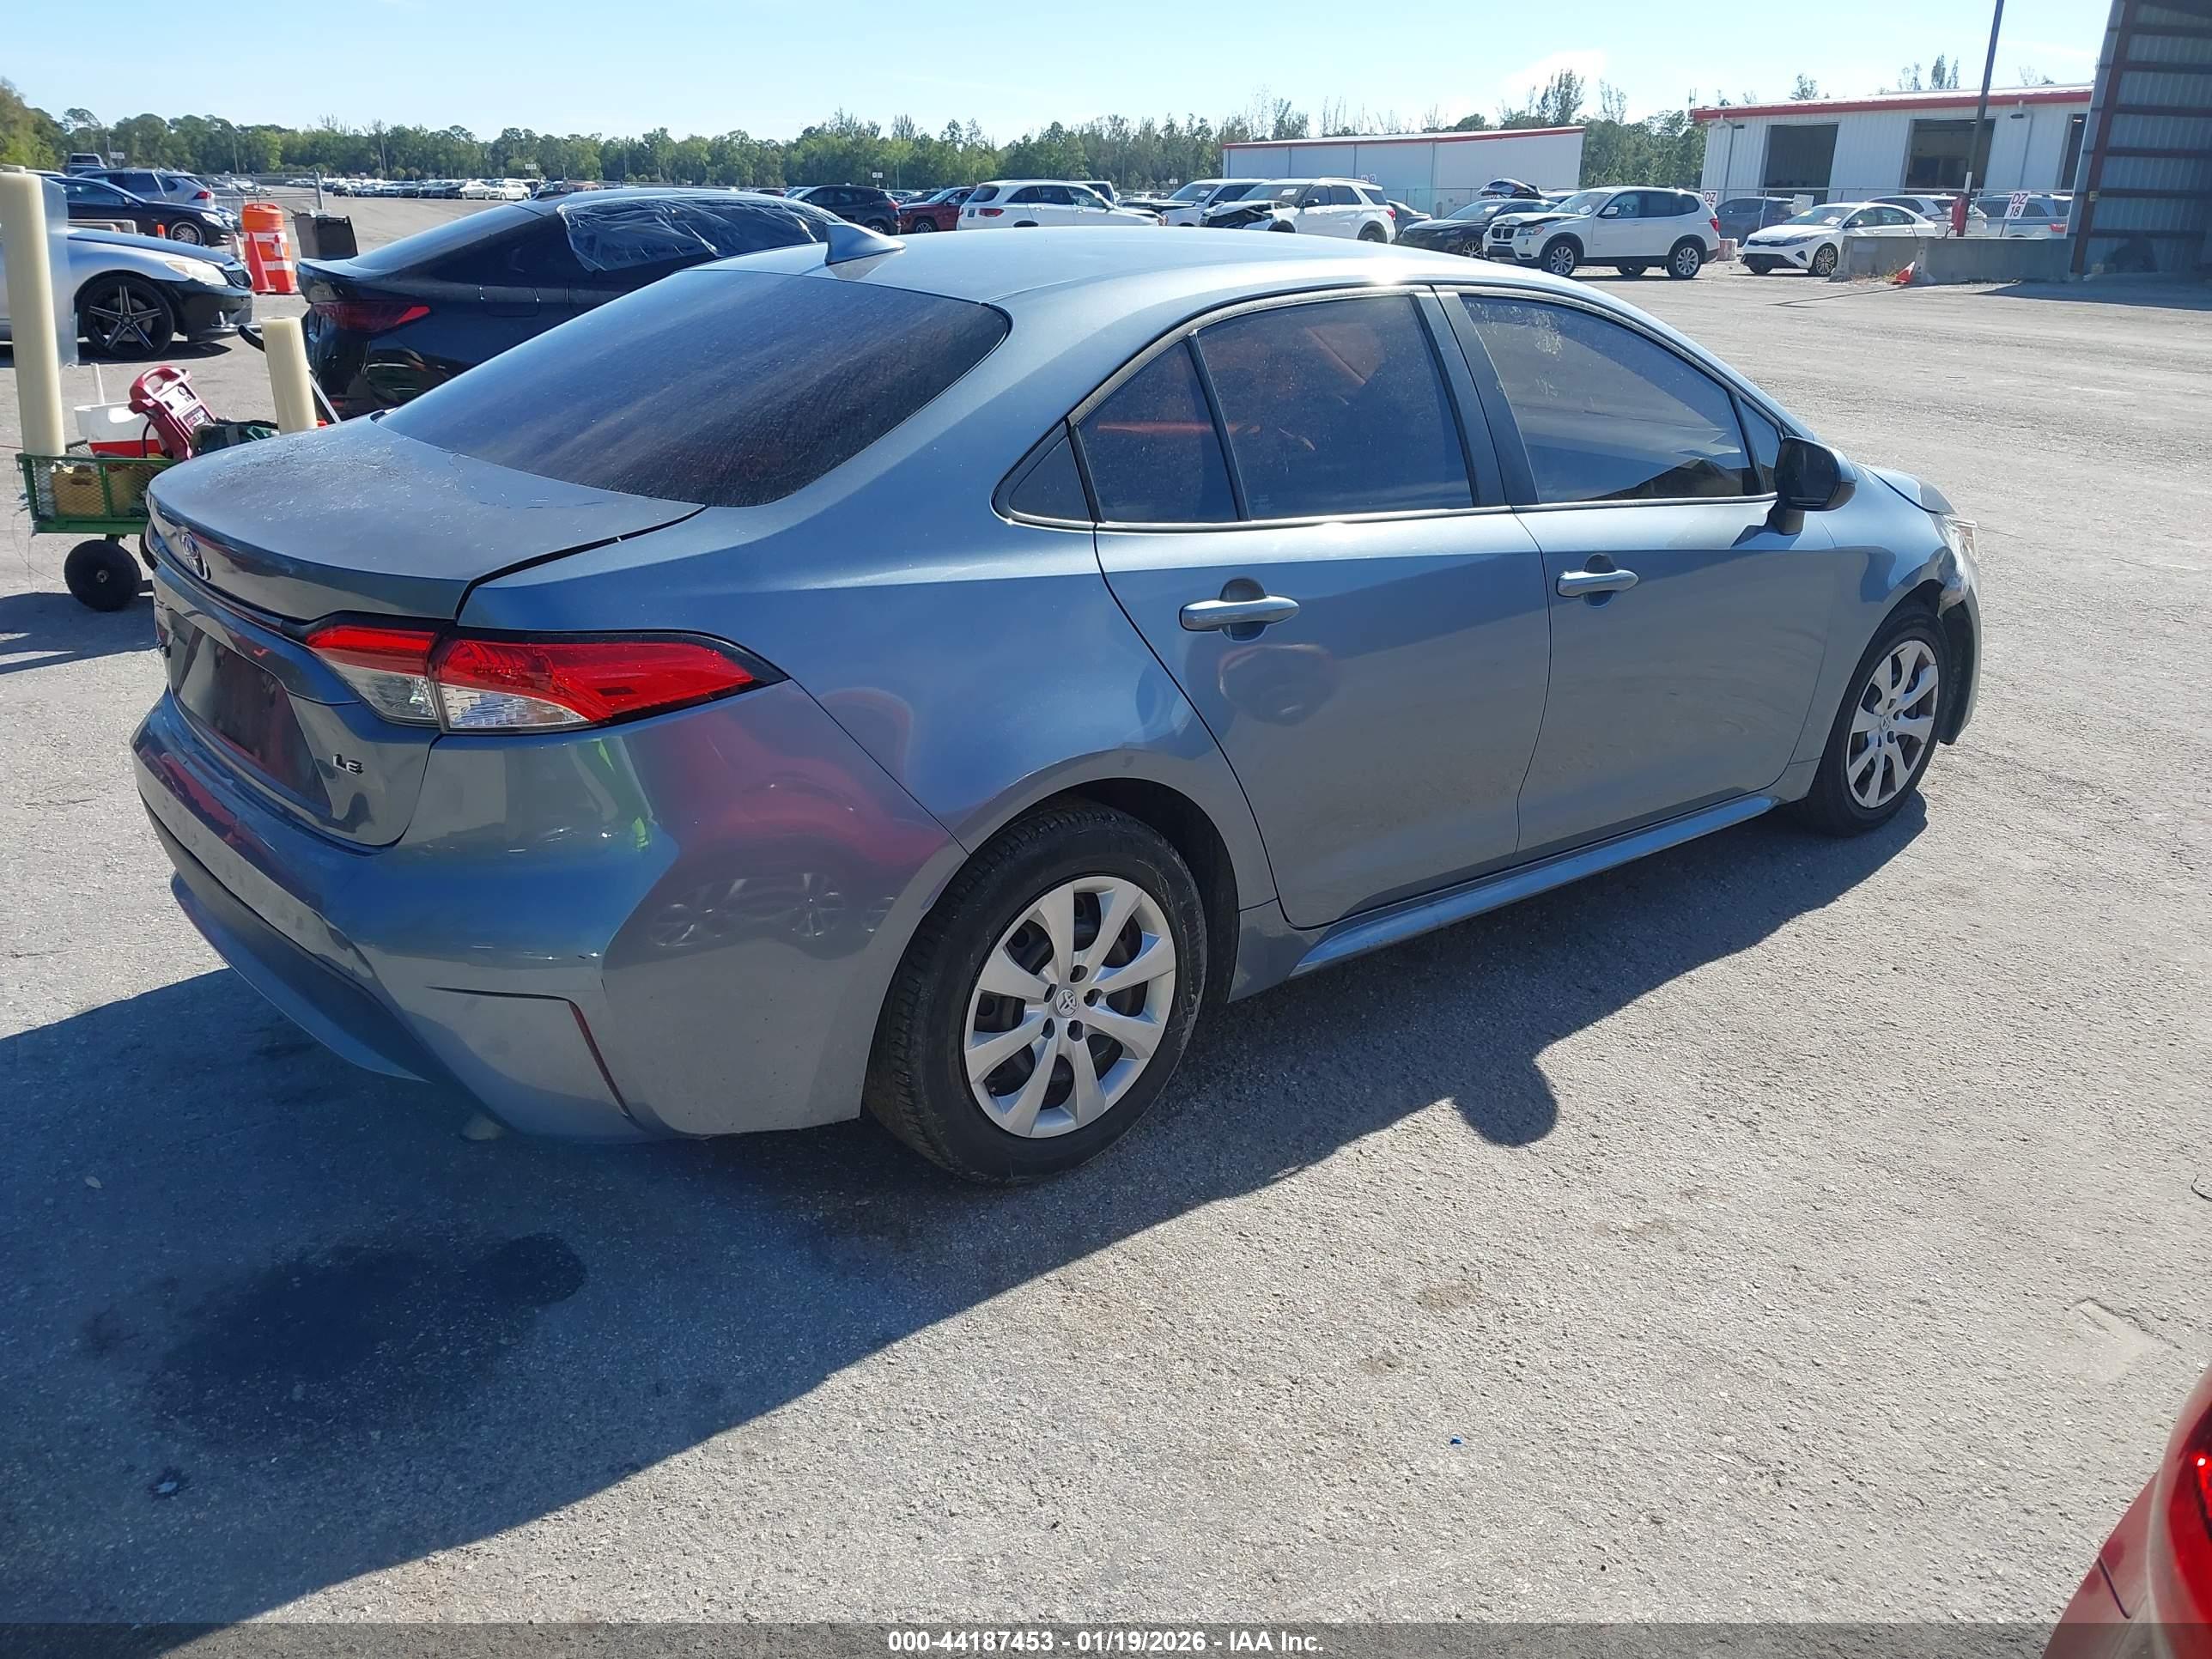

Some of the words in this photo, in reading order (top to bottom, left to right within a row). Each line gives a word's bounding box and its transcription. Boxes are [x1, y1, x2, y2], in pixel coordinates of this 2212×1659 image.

[1705, 191, 1717, 203] DZ
[2011, 192, 2028, 204] DZ
[2009, 205, 2021, 216] 18
[332, 753, 364, 775] LE
